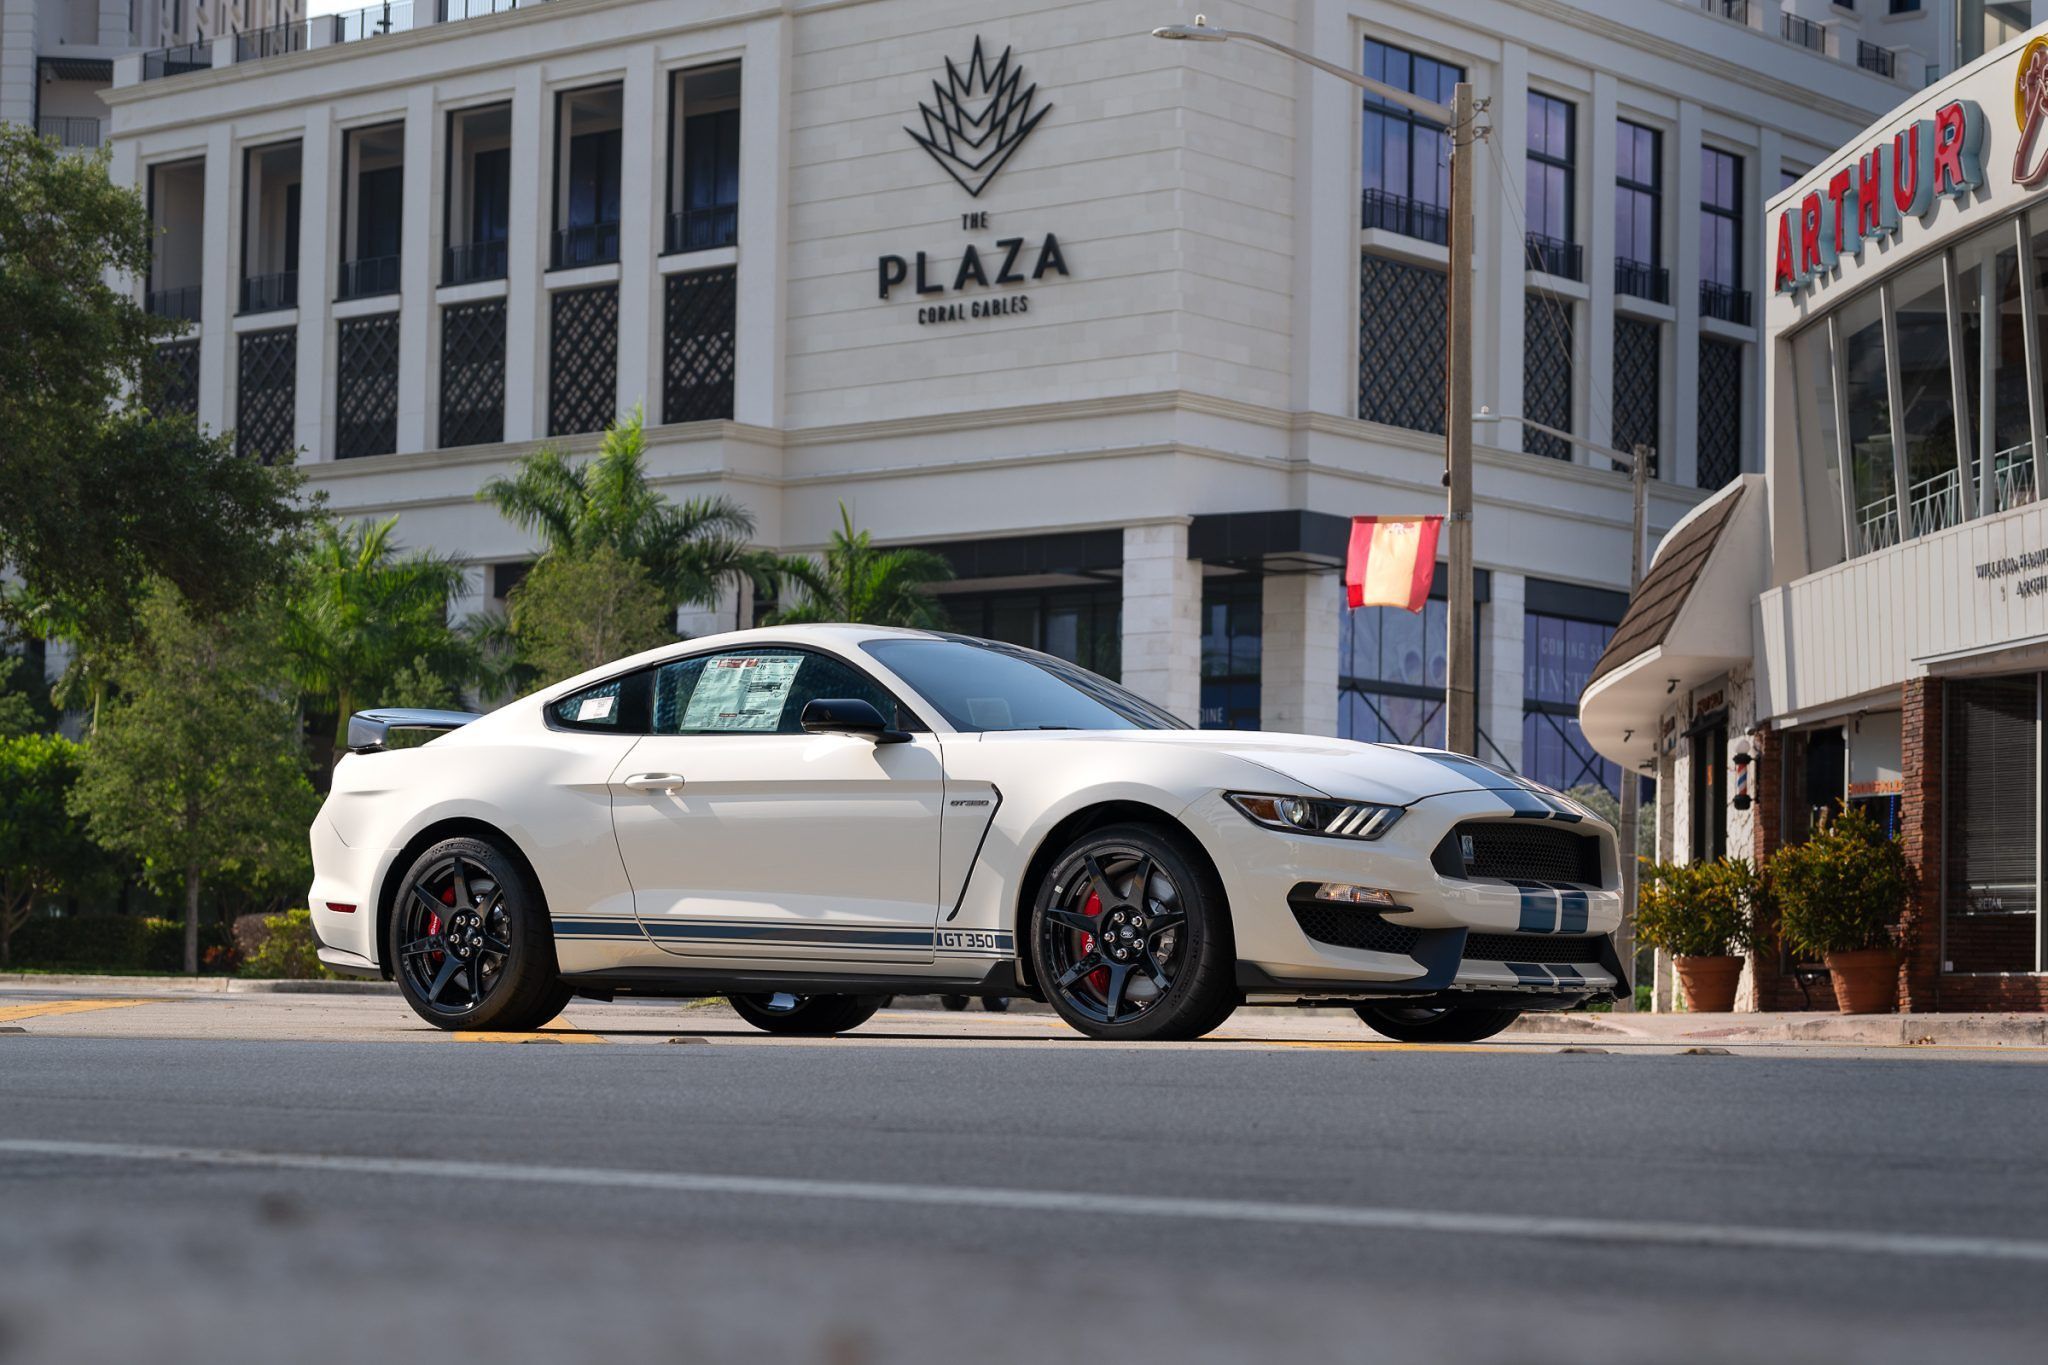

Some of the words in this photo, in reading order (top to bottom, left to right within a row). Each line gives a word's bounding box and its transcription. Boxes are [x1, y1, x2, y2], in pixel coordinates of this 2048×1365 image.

[1775, 99, 1984, 296] ARTHUR
[961, 211, 989, 230] THE
[878, 232, 1069, 299] PLAZA
[918, 303, 965, 325] CORAL
[971, 295, 1028, 318] GABLES
[1976, 558, 2018, 578] WILLIAM
[2016, 574, 2048, 597] ARCHI
[1541, 637, 1585, 660] COMING
[944, 933, 964, 947] GT
[967, 934, 994, 948] 350
